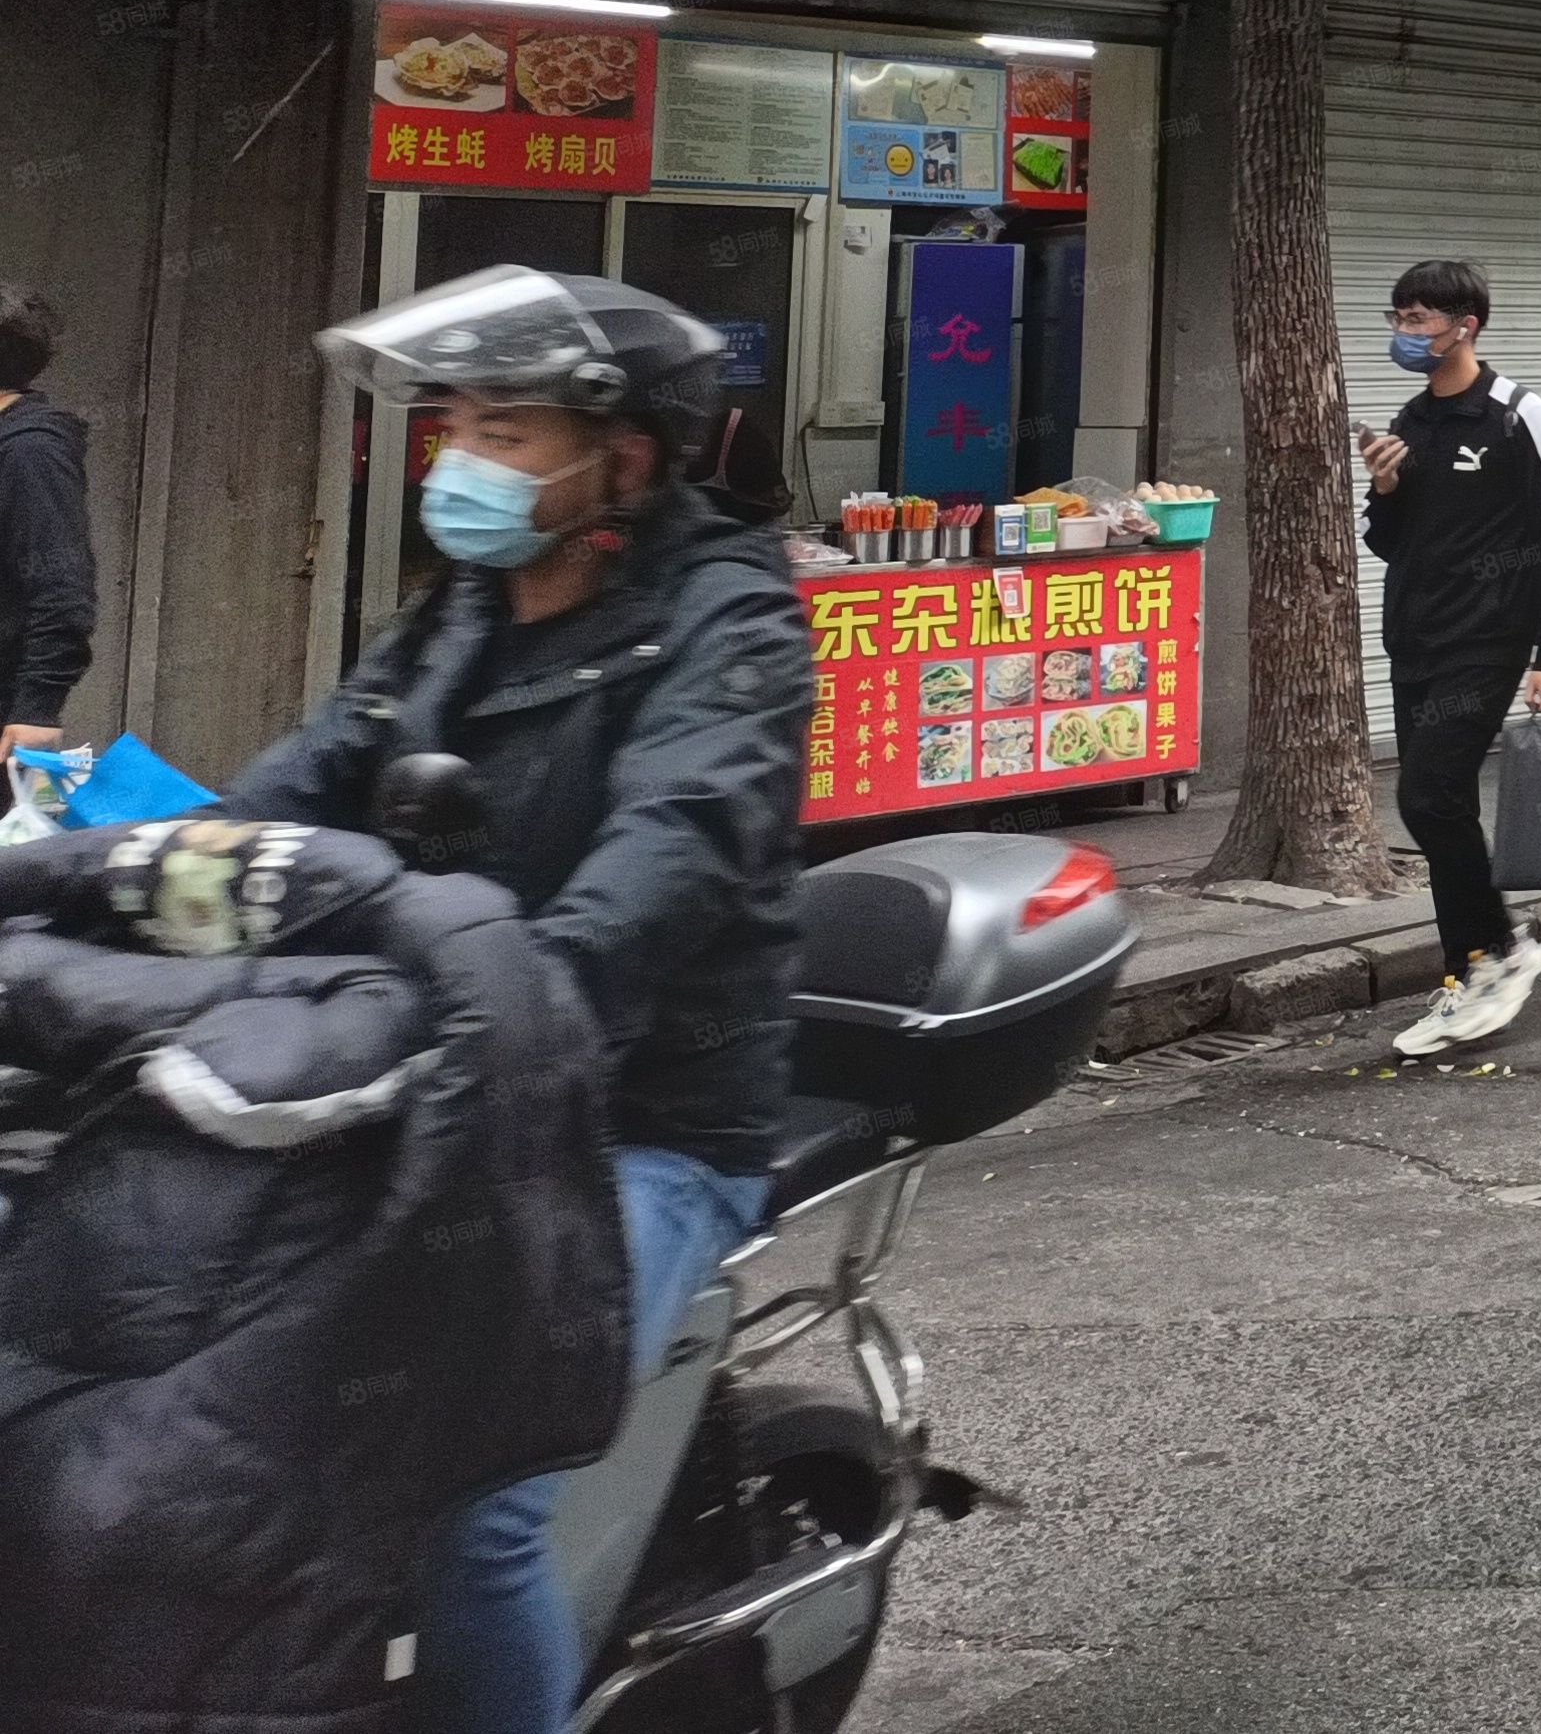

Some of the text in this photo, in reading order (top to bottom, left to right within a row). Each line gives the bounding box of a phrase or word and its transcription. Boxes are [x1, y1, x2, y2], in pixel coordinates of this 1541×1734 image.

[386, 122, 618, 177] 烤生蚝 烤扇贝
[809, 671, 836, 800] 五谷杂粮
[880, 667, 902, 763] 健康饮食
[1155, 638, 1178, 761] 煎饼果子
